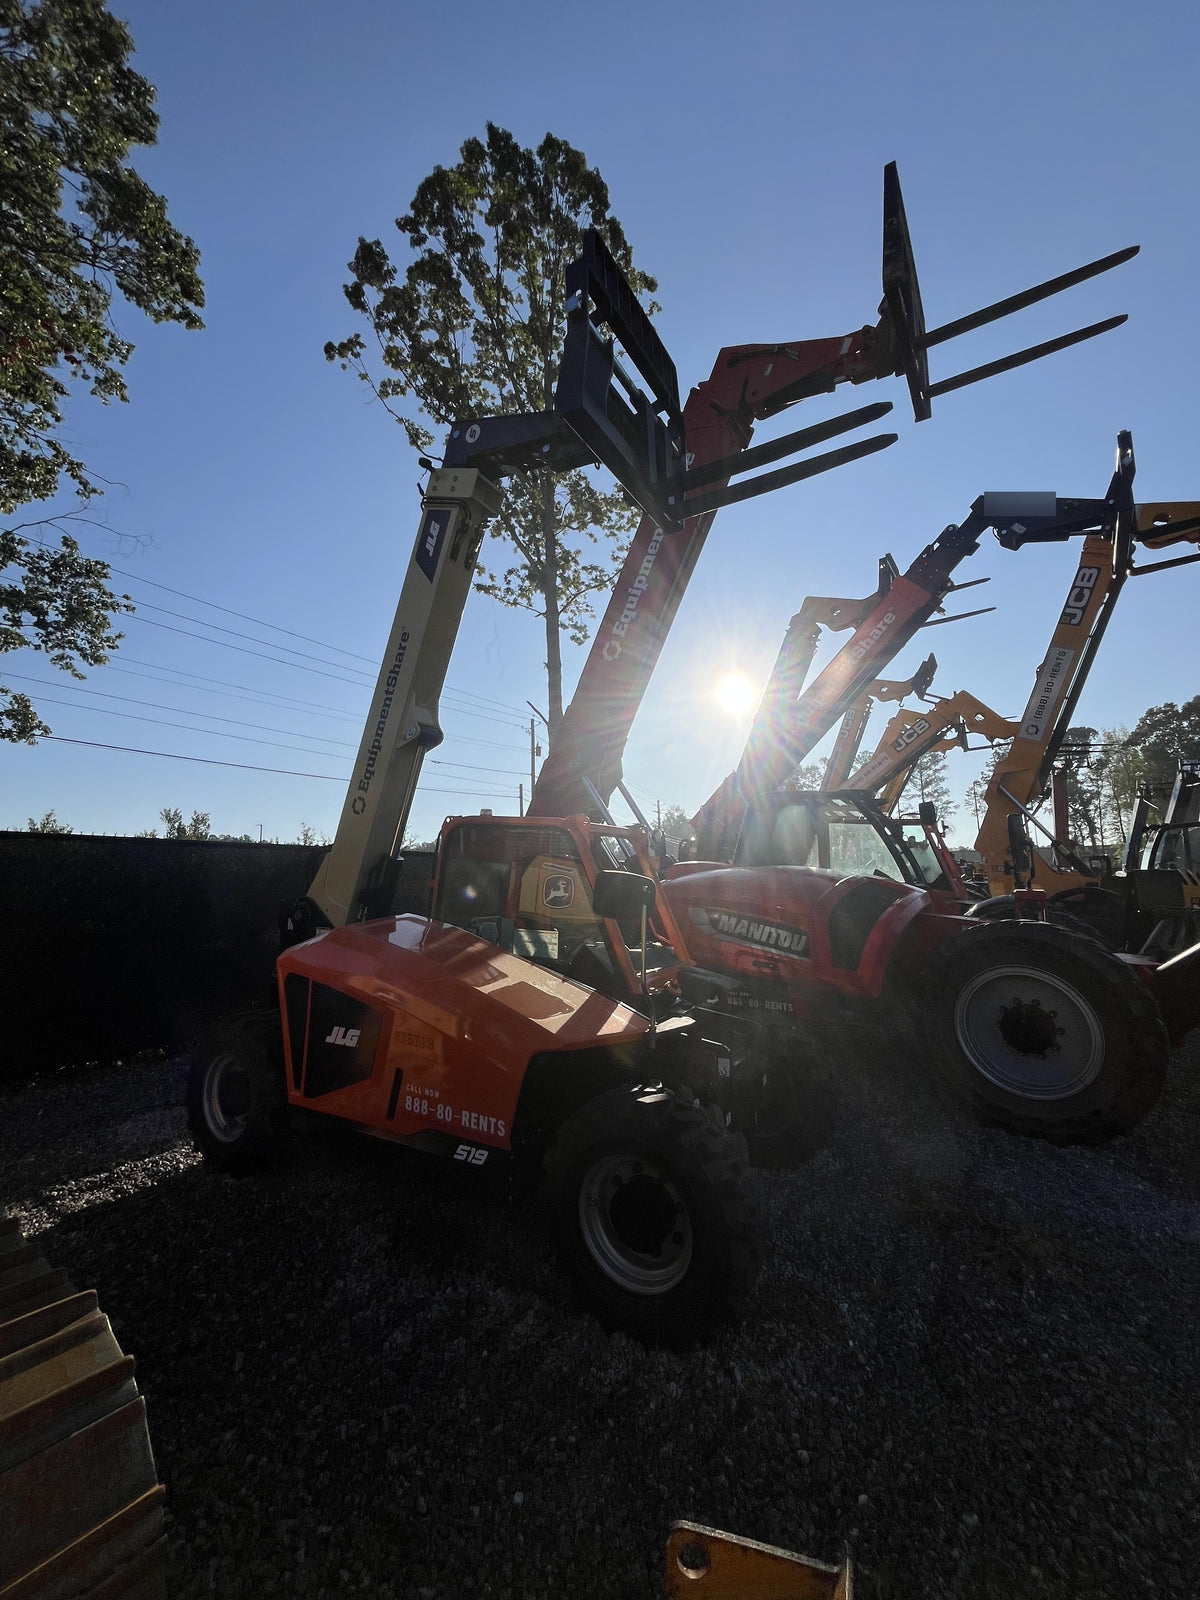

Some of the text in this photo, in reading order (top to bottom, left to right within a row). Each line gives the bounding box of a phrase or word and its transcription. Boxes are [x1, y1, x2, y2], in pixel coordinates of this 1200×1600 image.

[424, 520, 441, 558] JLG
[1062, 567, 1099, 625] JCB
[1033, 651, 1067, 720] (888) 80-RENTS
[358, 631, 410, 794] EquipmentShare
[840, 709, 856, 738] JCB
[893, 719, 930, 751] JCB
[718, 914, 807, 952] MANITOU
[324, 1026, 362, 1048] JLG
[406, 1083, 440, 1099] CALL NOW
[405, 1095, 506, 1137] 888-80-RENTS
[452, 1144, 489, 1166] 519
